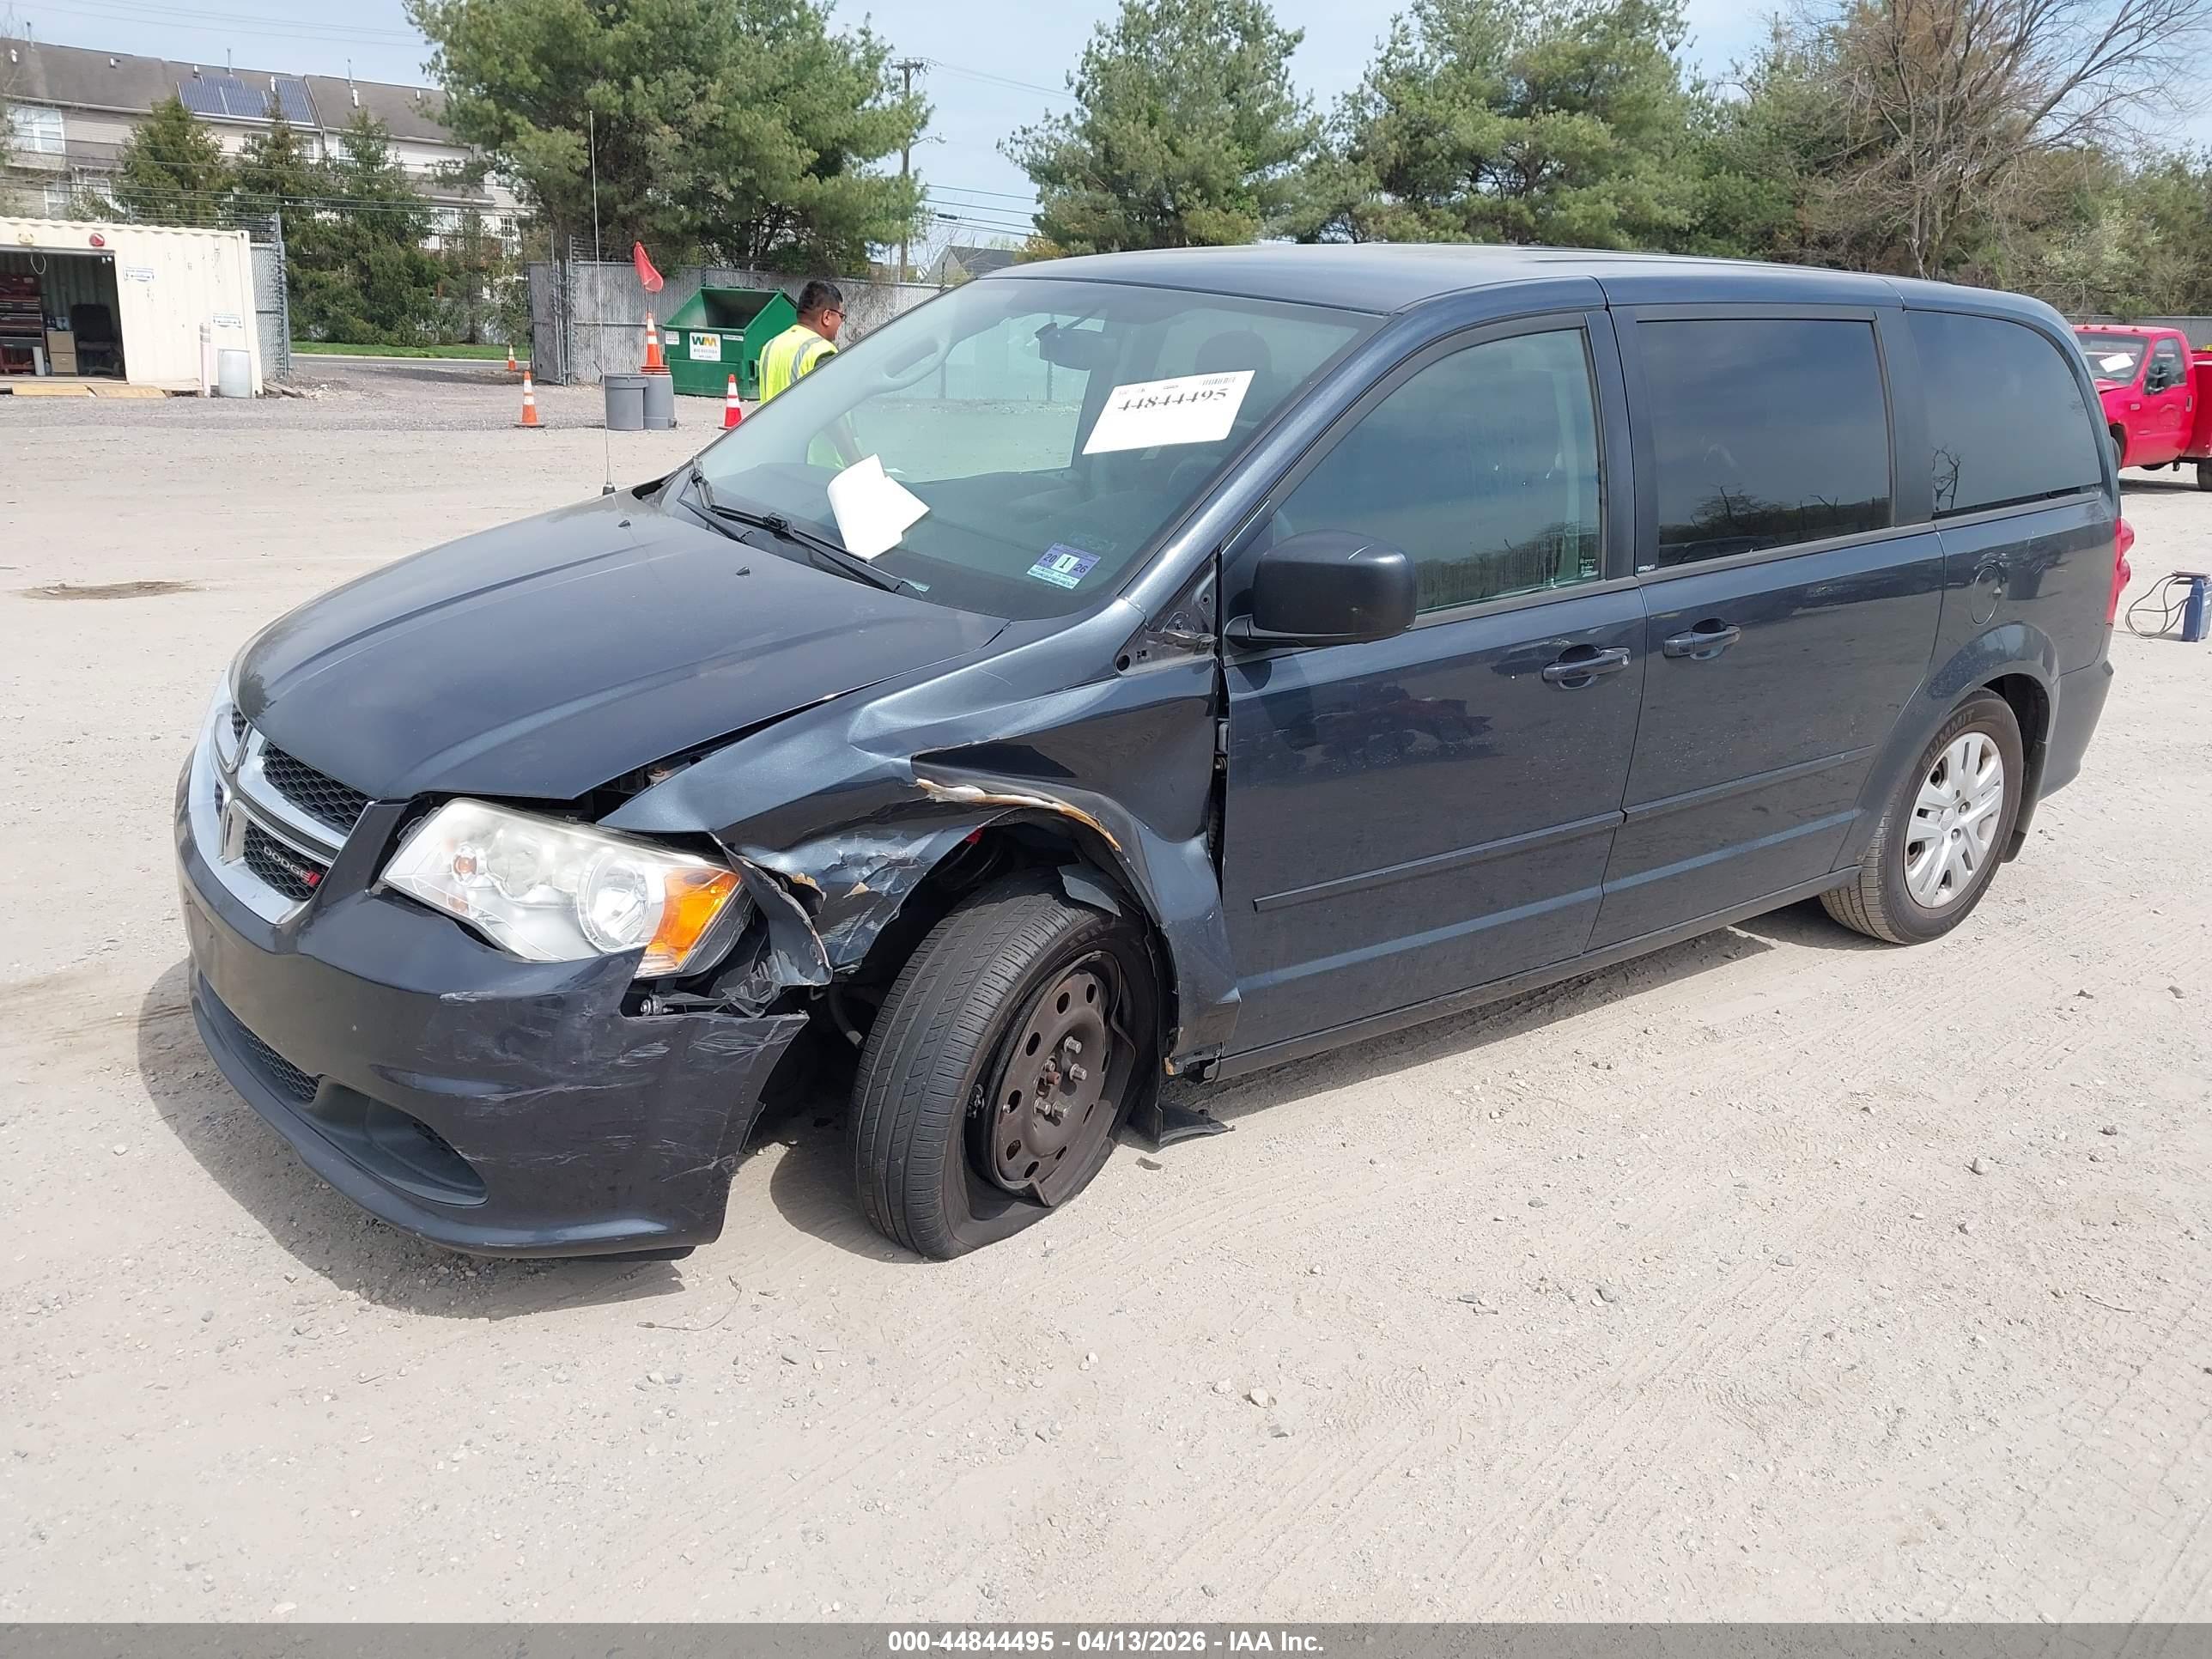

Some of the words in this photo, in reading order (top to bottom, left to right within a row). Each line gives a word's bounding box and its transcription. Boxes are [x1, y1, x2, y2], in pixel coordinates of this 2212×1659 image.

[691, 336, 717, 347] WM
[1118, 388, 1229, 410] 44844495
[1043, 553, 1058, 563] 20
[1059, 556, 1072, 569] 1
[1073, 563, 1089, 574] 26
[1922, 708, 1975, 772] SUMMIT
[263, 845, 311, 883] DODGE
